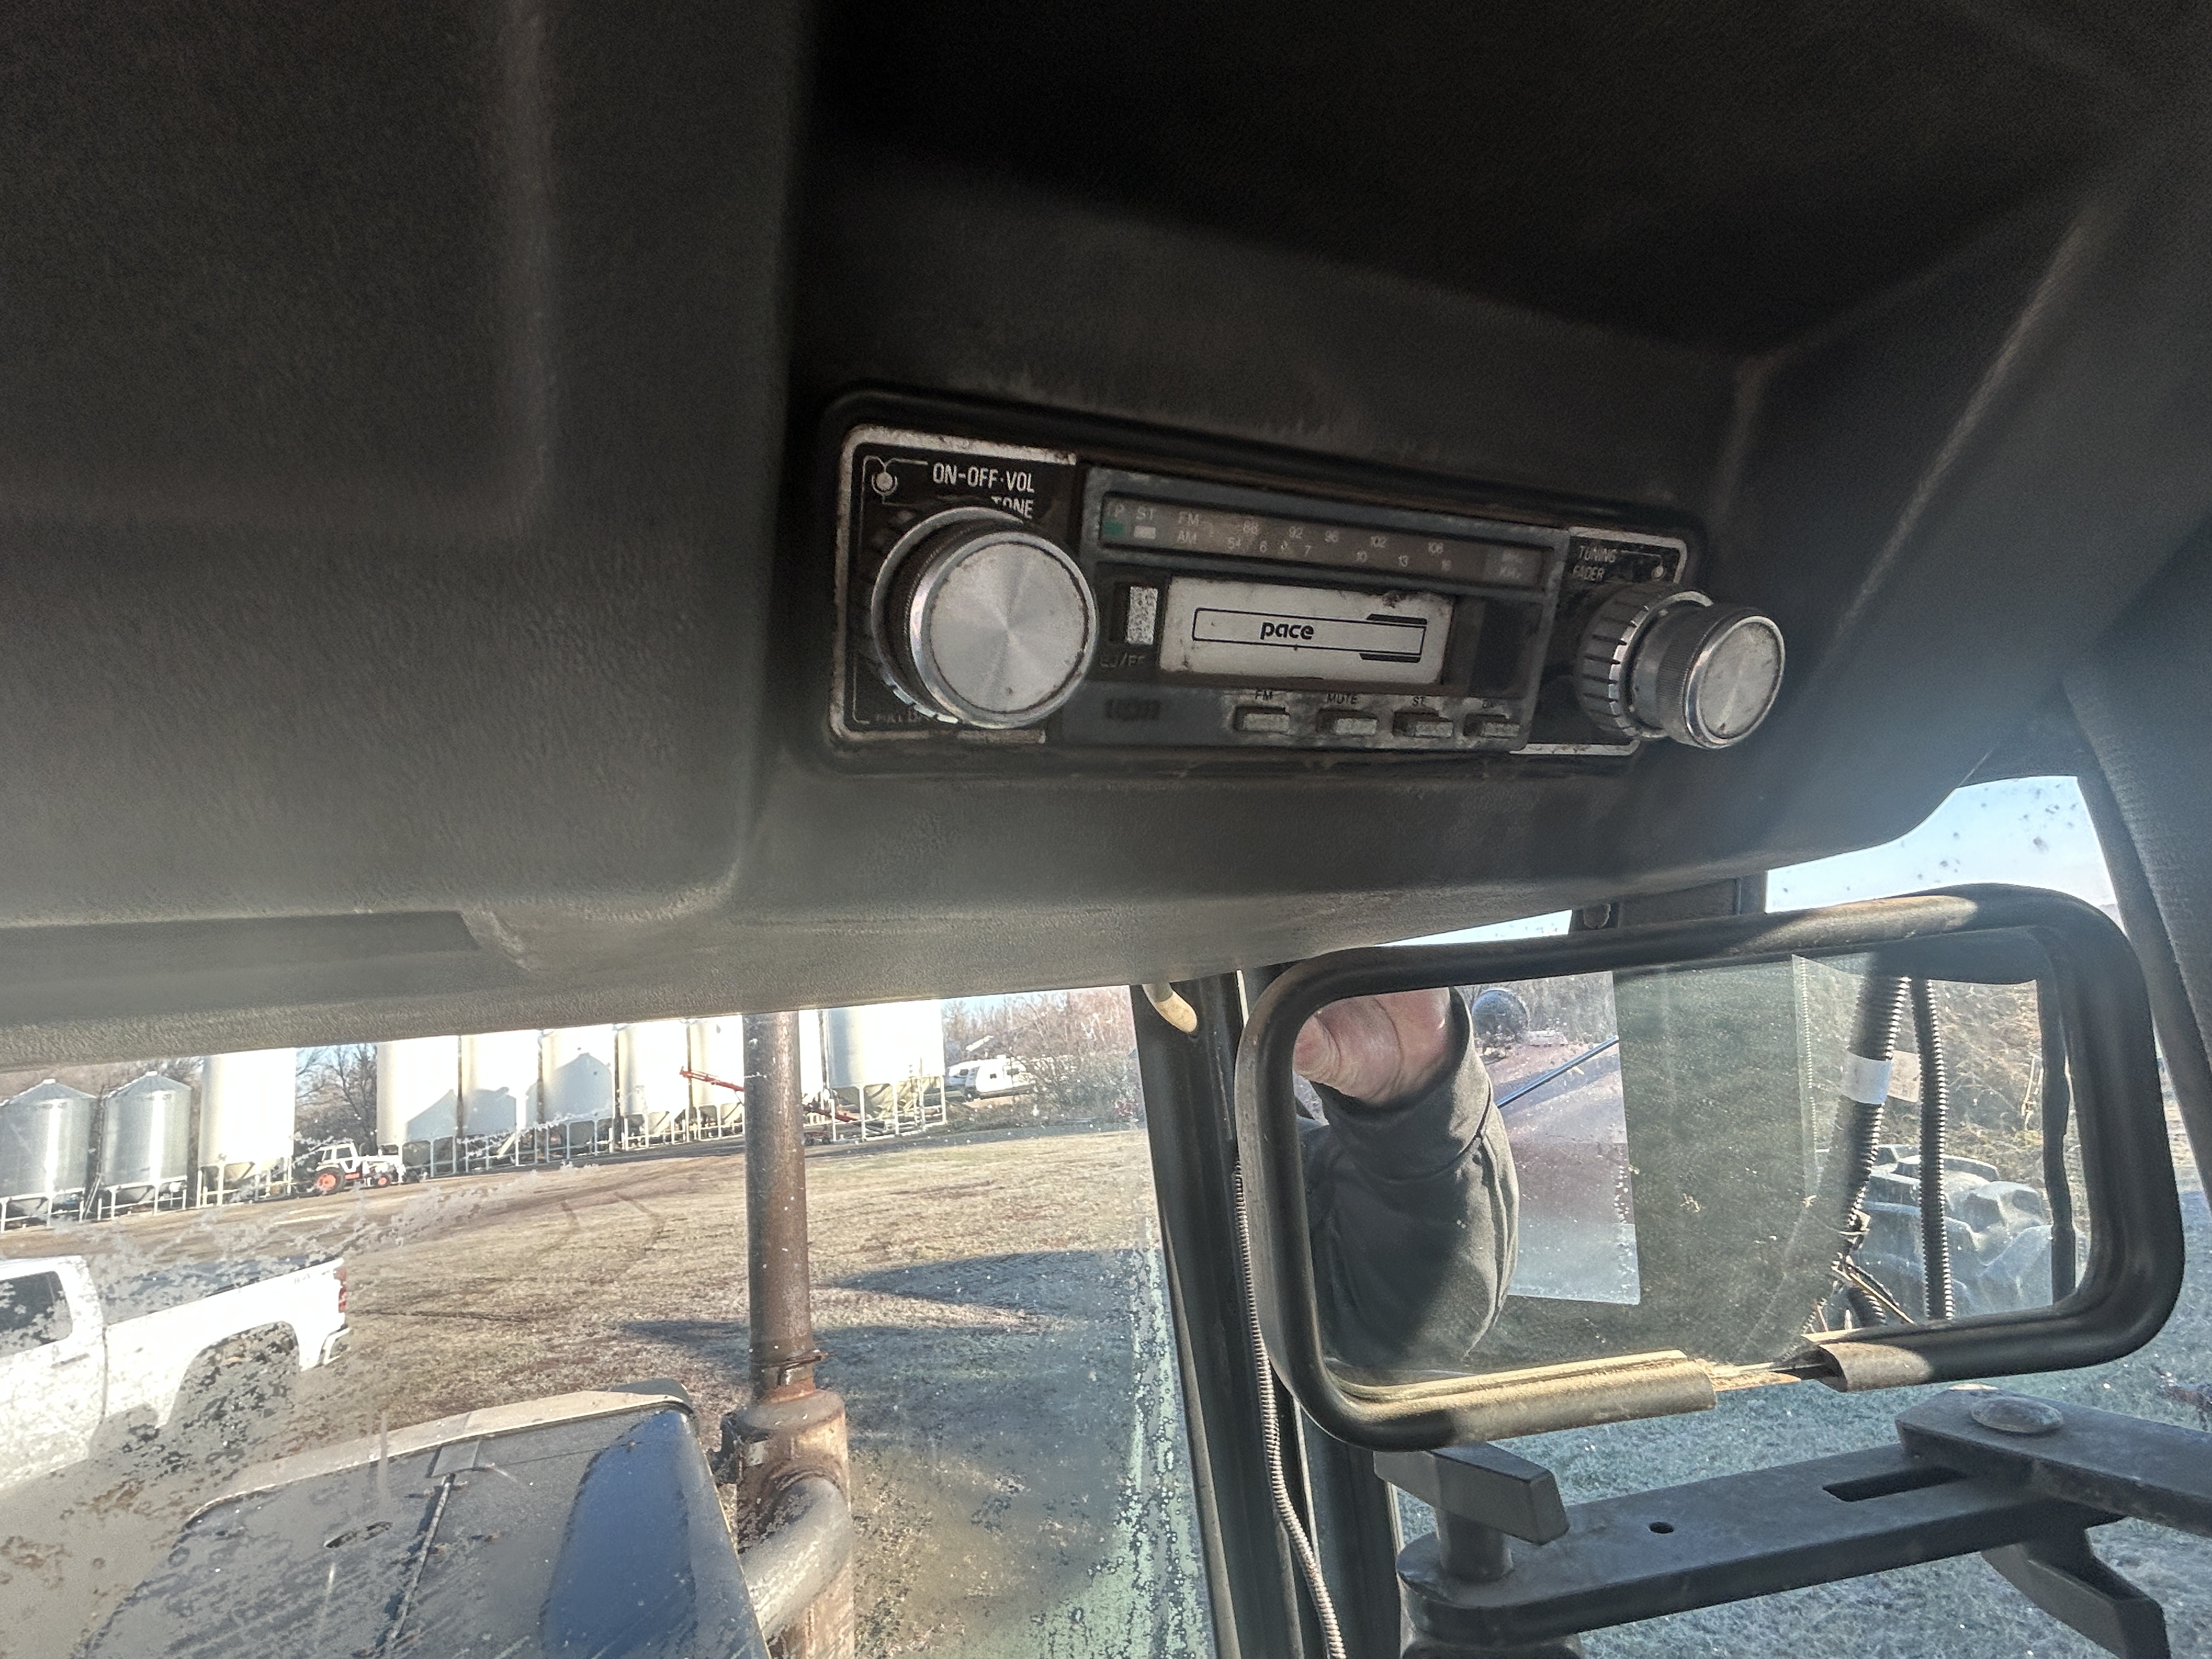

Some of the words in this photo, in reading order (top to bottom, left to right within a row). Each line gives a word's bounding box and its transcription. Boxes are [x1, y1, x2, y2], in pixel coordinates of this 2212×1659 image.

[1178, 511, 1200, 527] FM
[1289, 526, 1304, 539] 92
[1370, 535, 1387, 548] 102
[1305, 545, 1313, 557] 7
[1578, 545, 1617, 563] TUNING
[1260, 621, 1314, 641] pace
[1327, 693, 1358, 705] MUTE
